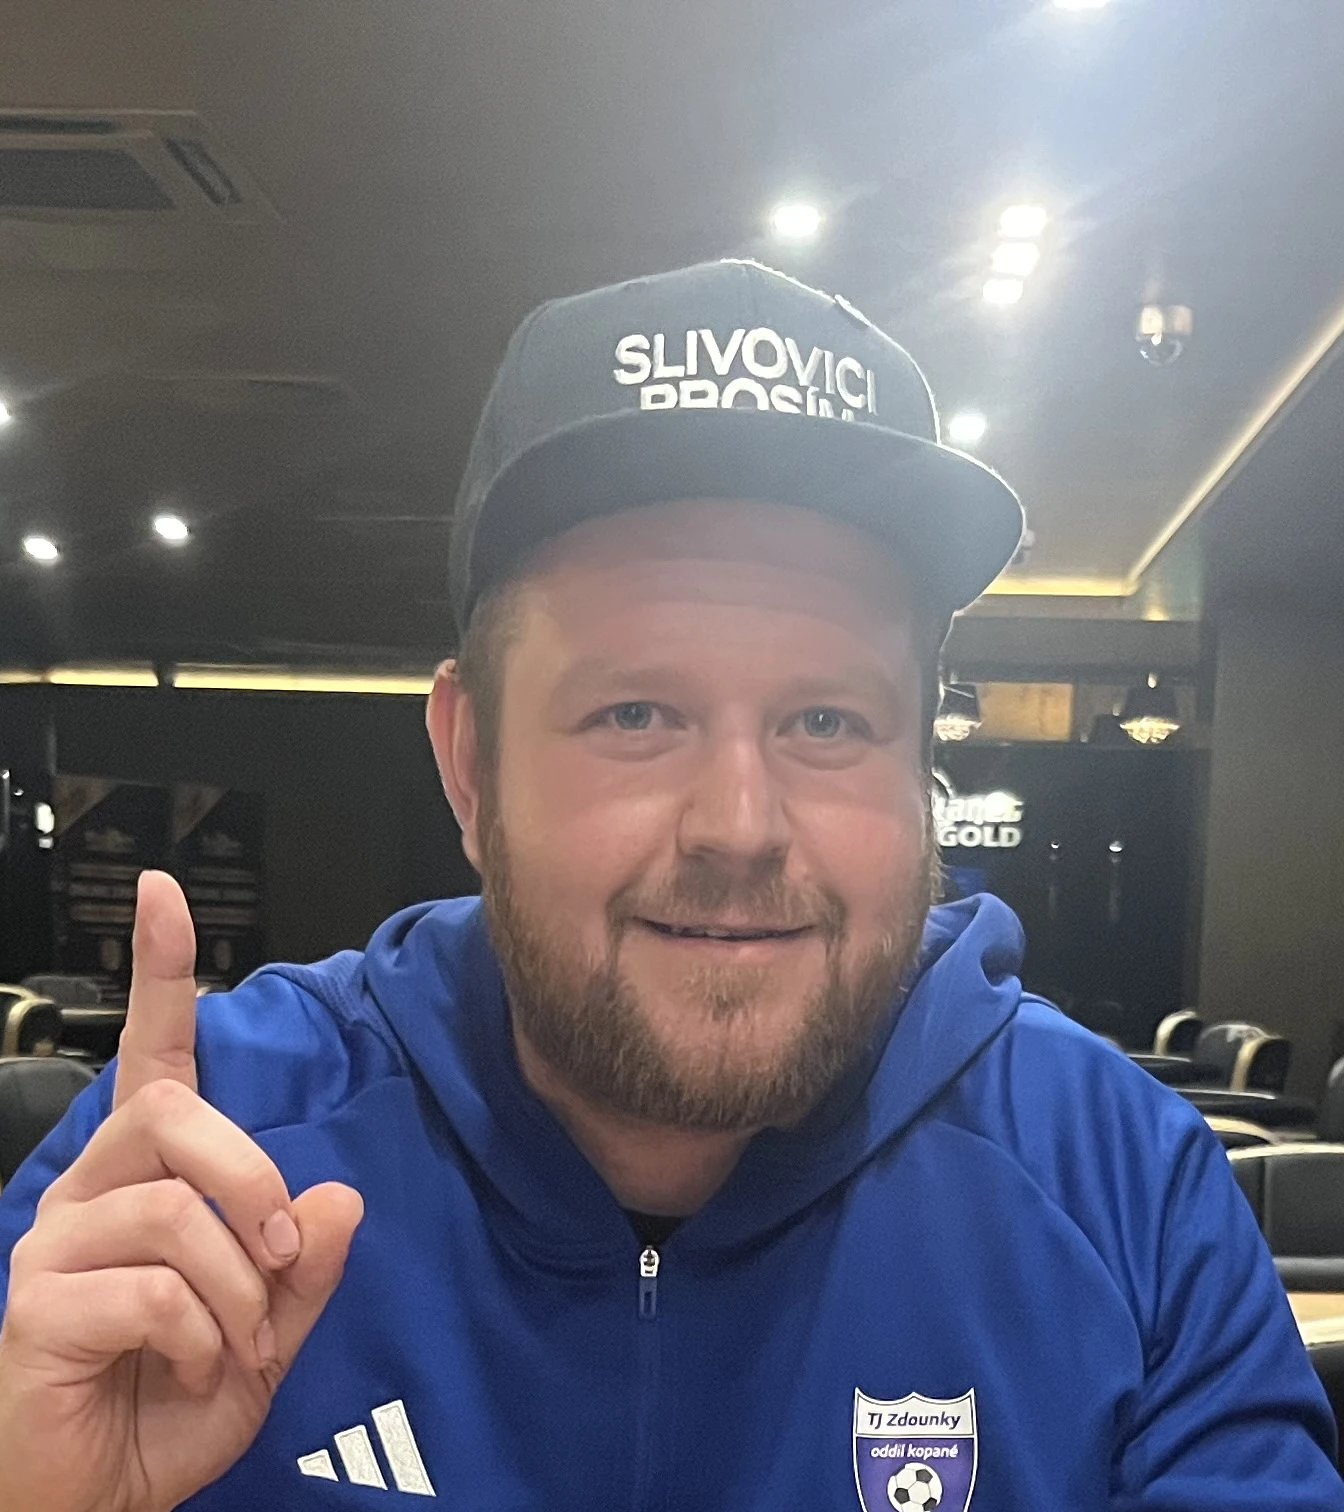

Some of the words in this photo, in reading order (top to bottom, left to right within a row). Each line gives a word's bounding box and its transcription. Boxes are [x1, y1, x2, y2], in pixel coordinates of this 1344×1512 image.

[613, 327, 878, 415] SLIVOVICI
[937, 825, 1022, 848] GOLD
[867, 1412, 883, 1429] TJ
[887, 1411, 961, 1430] Zdounky
[907, 1443, 958, 1460] kopané
